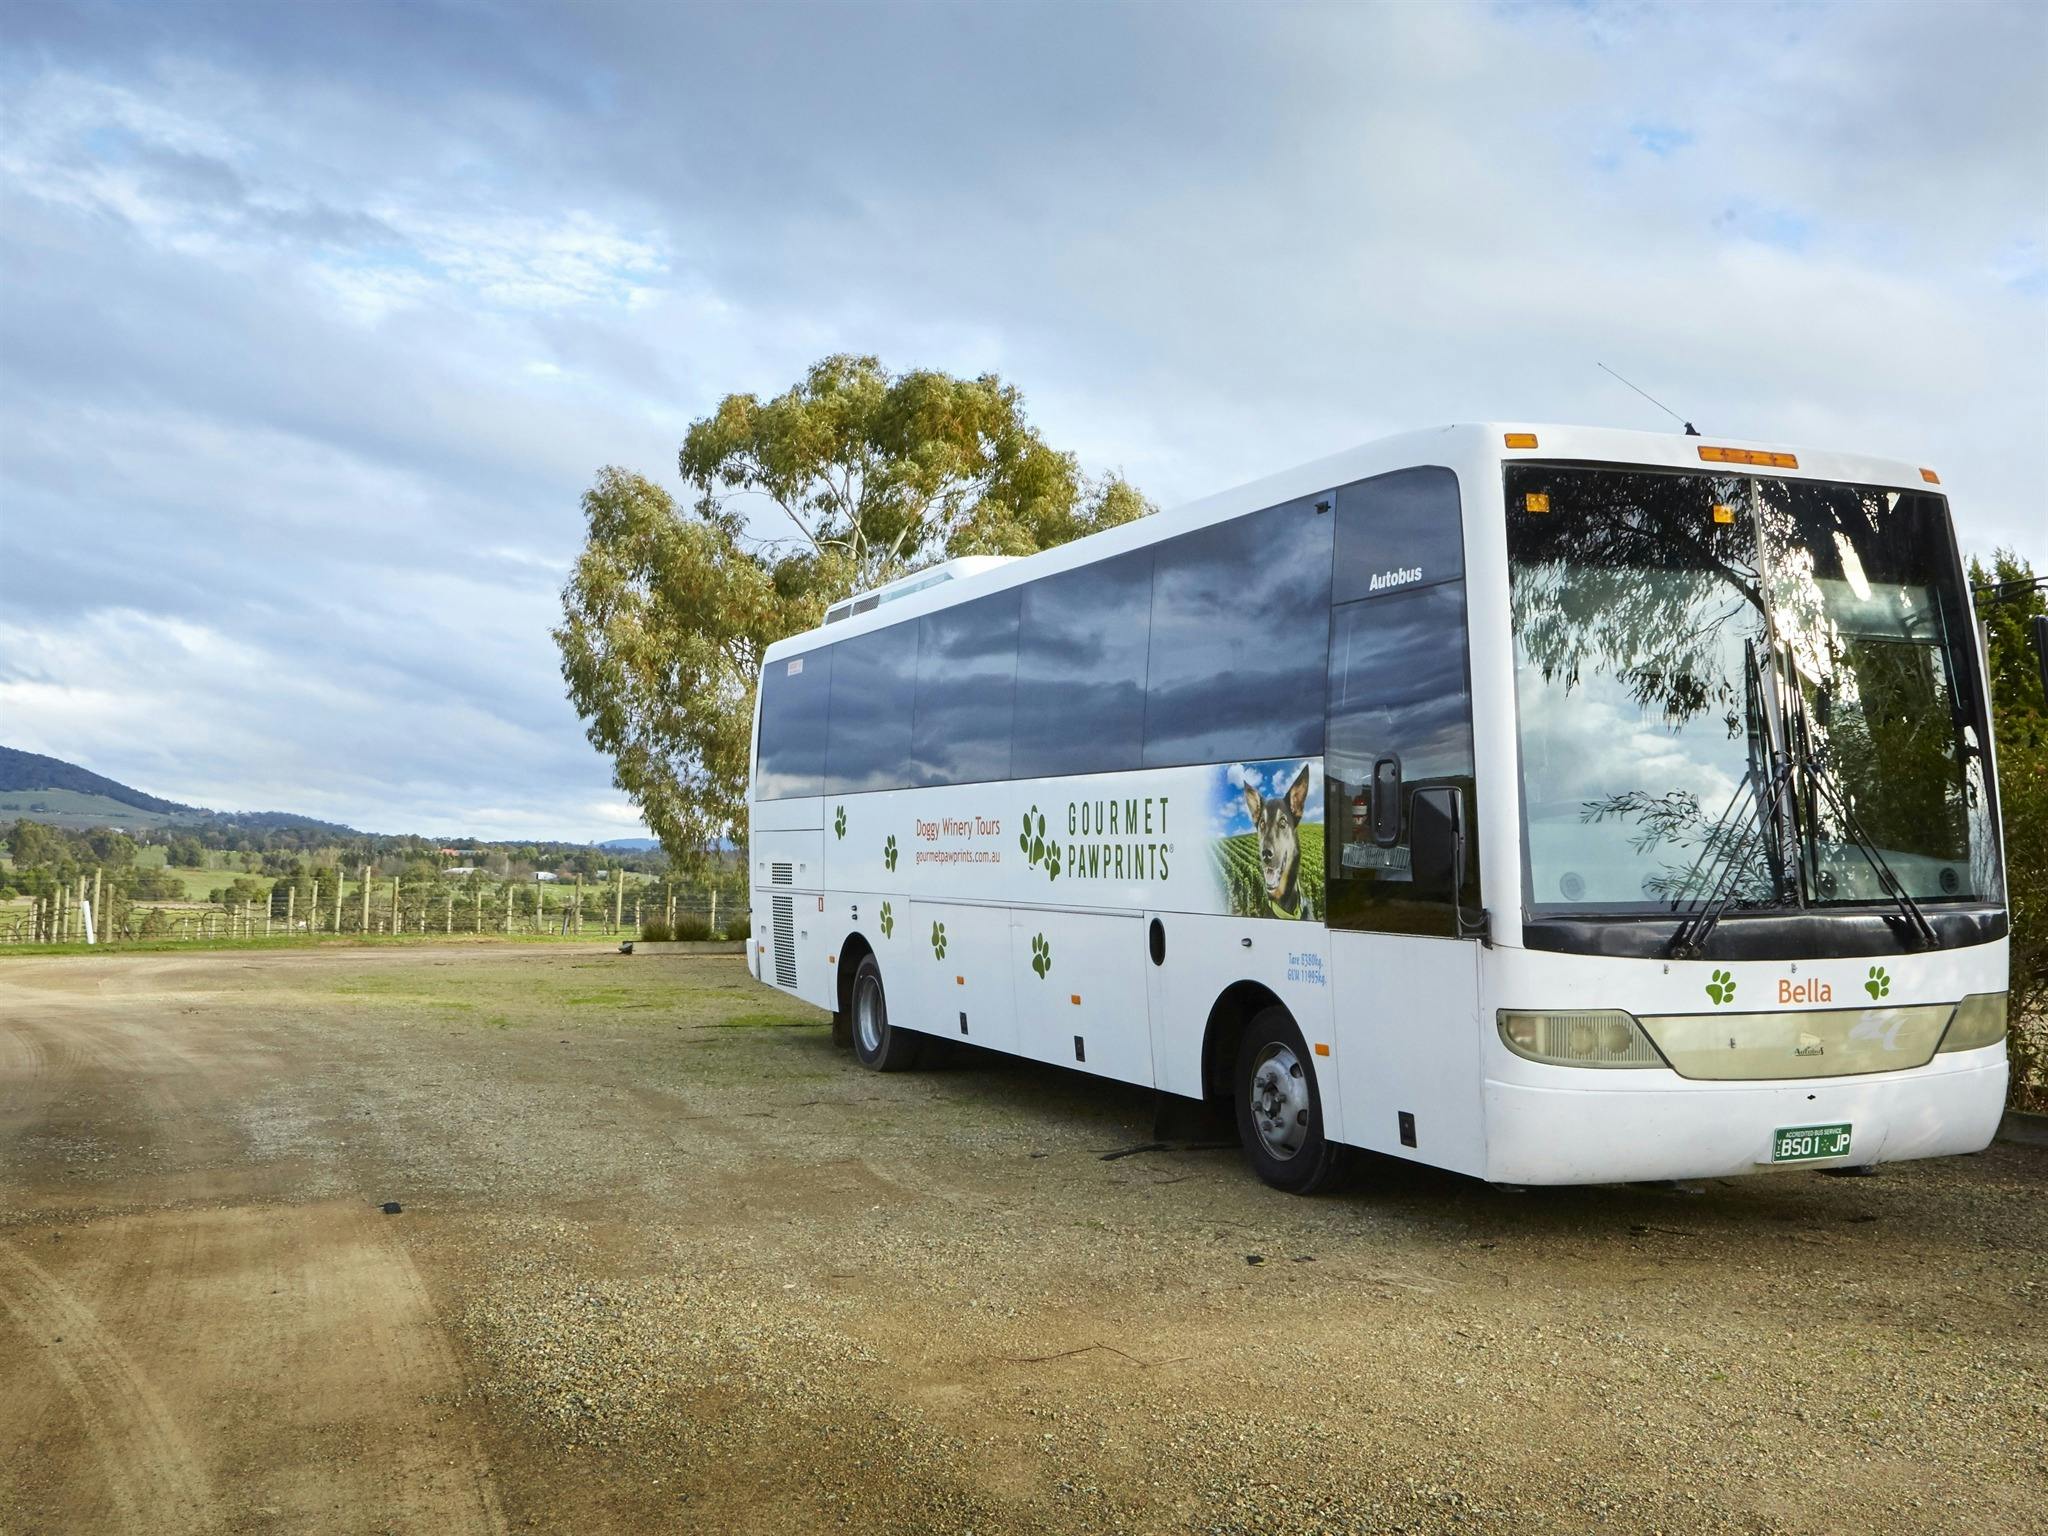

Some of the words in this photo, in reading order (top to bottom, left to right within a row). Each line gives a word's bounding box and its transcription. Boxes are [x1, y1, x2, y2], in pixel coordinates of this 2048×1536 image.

[1369, 567, 1422, 591] Autobus
[916, 818, 940, 841] Doggy
[942, 817, 973, 840] Winery
[975, 816, 1001, 836] Tours
[1068, 797, 1169, 836] GOURMET
[916, 849, 1001, 866] gourmetpawprints.com.au
[1779, 978, 1832, 1004] Bella
[1823, 1127, 1843, 1136] SERVICE
[1781, 1136, 1820, 1157] BS01
[1830, 1133, 1850, 1153] JP
